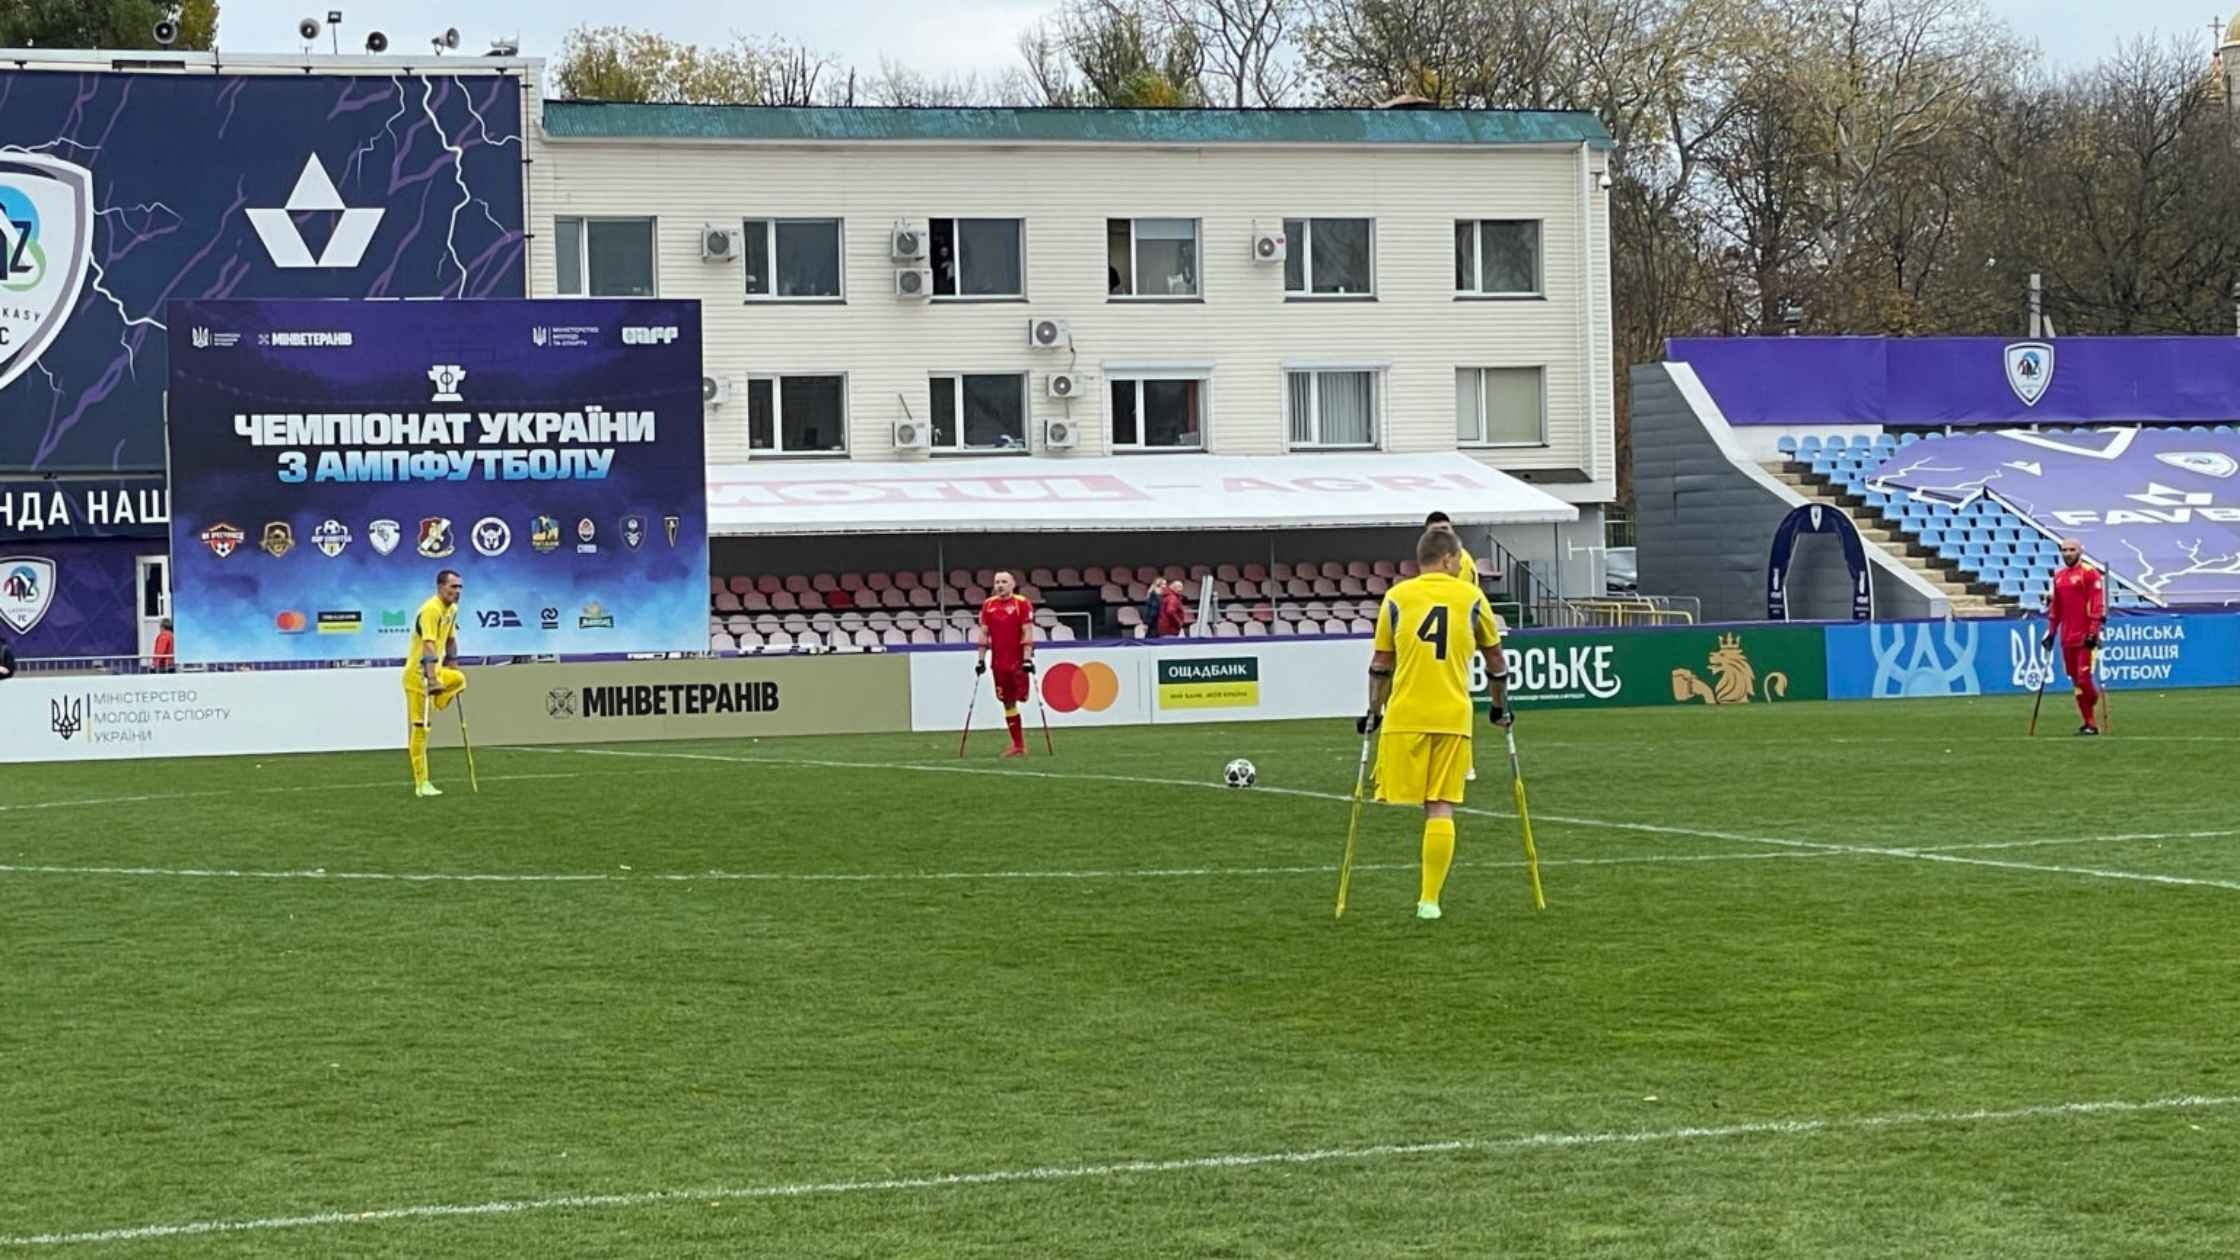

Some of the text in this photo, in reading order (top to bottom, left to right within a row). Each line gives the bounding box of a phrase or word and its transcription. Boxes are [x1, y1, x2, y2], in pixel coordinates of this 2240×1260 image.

[234, 405, 656, 446] ЧЕМПІОНАТ УКРАЇНИ
[277, 449, 616, 483] З АМПФУТБОЛУ
[1222, 473, 1486, 493] AGRI
[1417, 606, 1448, 660] 4
[2099, 645, 2179, 661] СОЦІАЦІЯ
[1168, 664, 1248, 680] ОЩАДБАНК
[94, 690, 197, 705] МІНІСТЕРСТВО
[582, 682, 779, 717] МІНВЕТЕРАНІВ
[95, 708, 231, 724] МОЛОДІ ТА СПОРТУ
[94, 730, 153, 744] УКРАЇНИ
